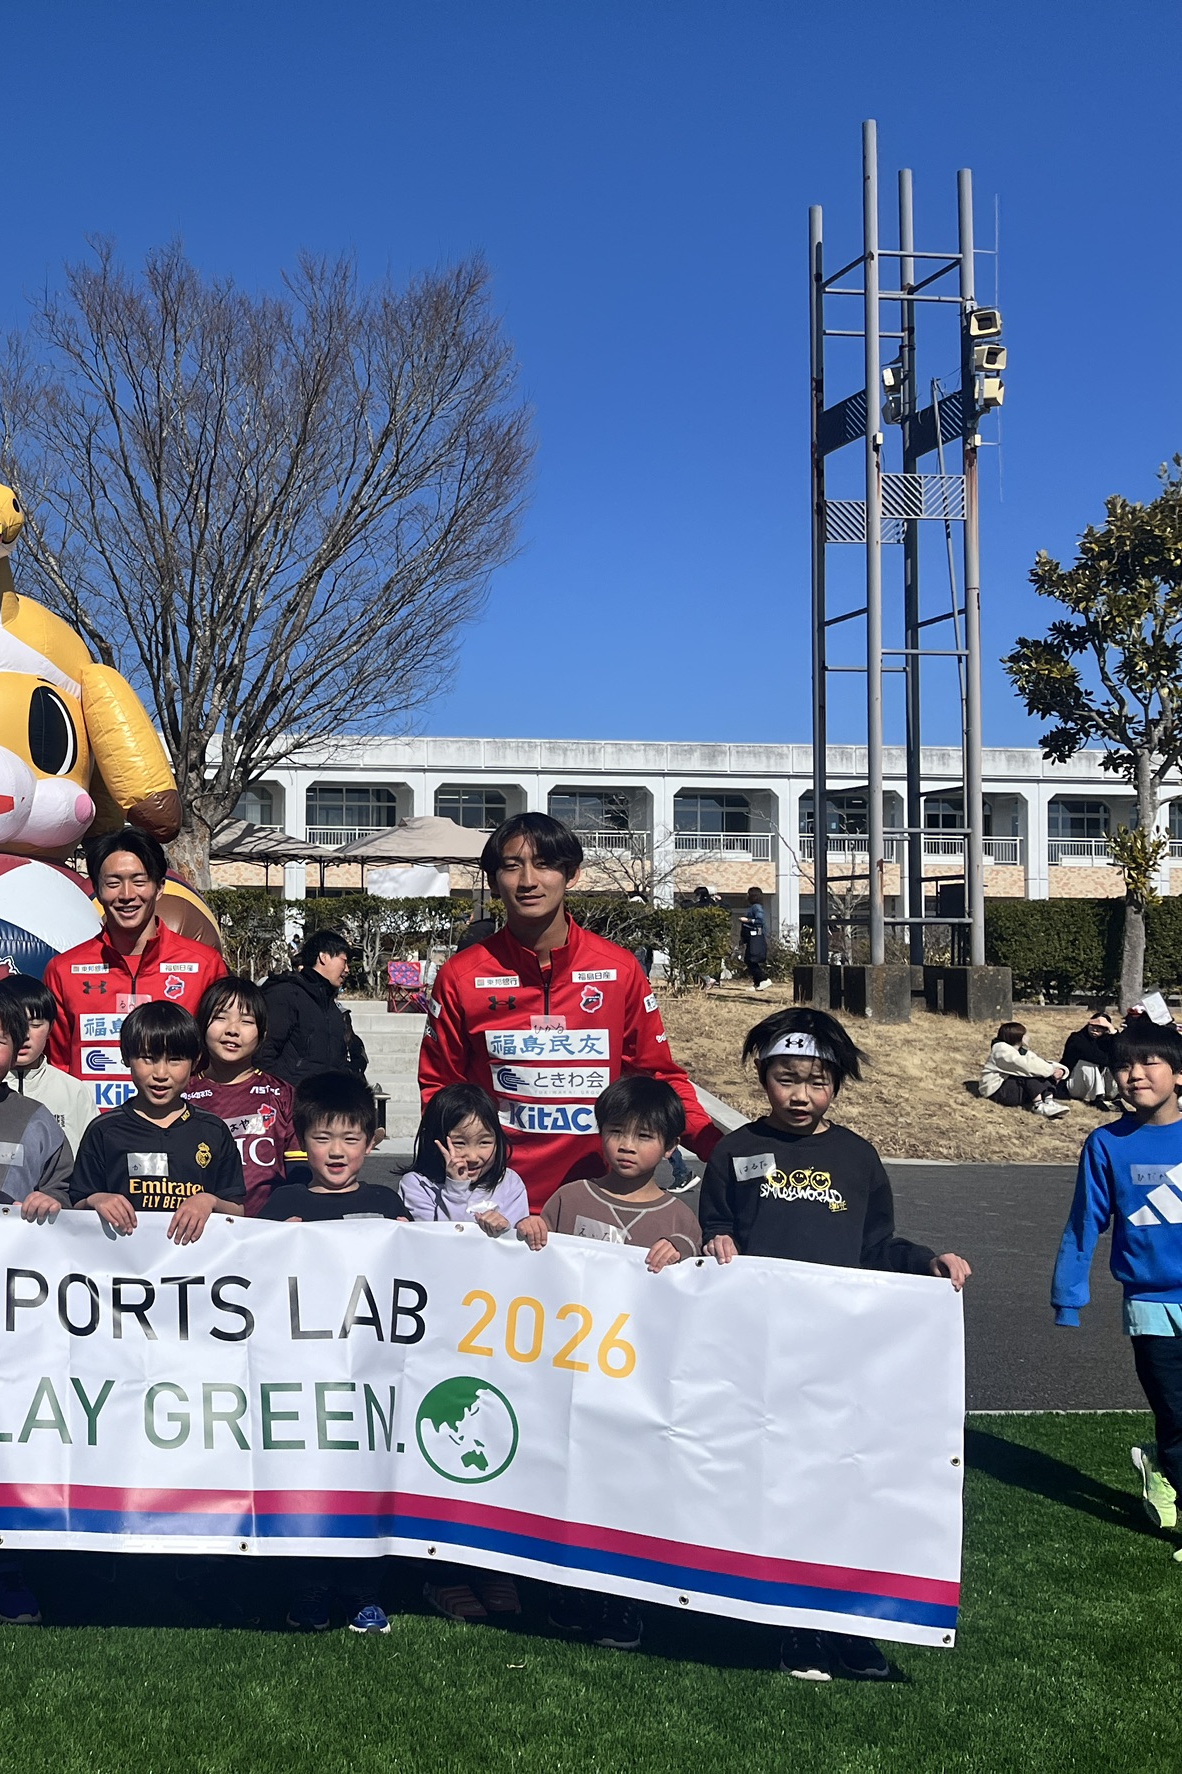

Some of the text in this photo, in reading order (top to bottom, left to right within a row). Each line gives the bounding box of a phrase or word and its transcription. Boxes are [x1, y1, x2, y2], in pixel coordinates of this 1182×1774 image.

[486, 978, 518, 987] 東邦銀行
[577, 970, 611, 981] 福島日産
[490, 1034, 604, 1056] 福島民友
[533, 1071, 604, 1089] ときわ会
[509, 1103, 593, 1132] KitAC
[129, 1178, 204, 1196] Emirate
[142, 1195, 161, 1208] FLY
[287, 1275, 428, 1345] LAB
[457, 1289, 636, 1379] 2026
[144, 1381, 405, 1454] GREEN.
